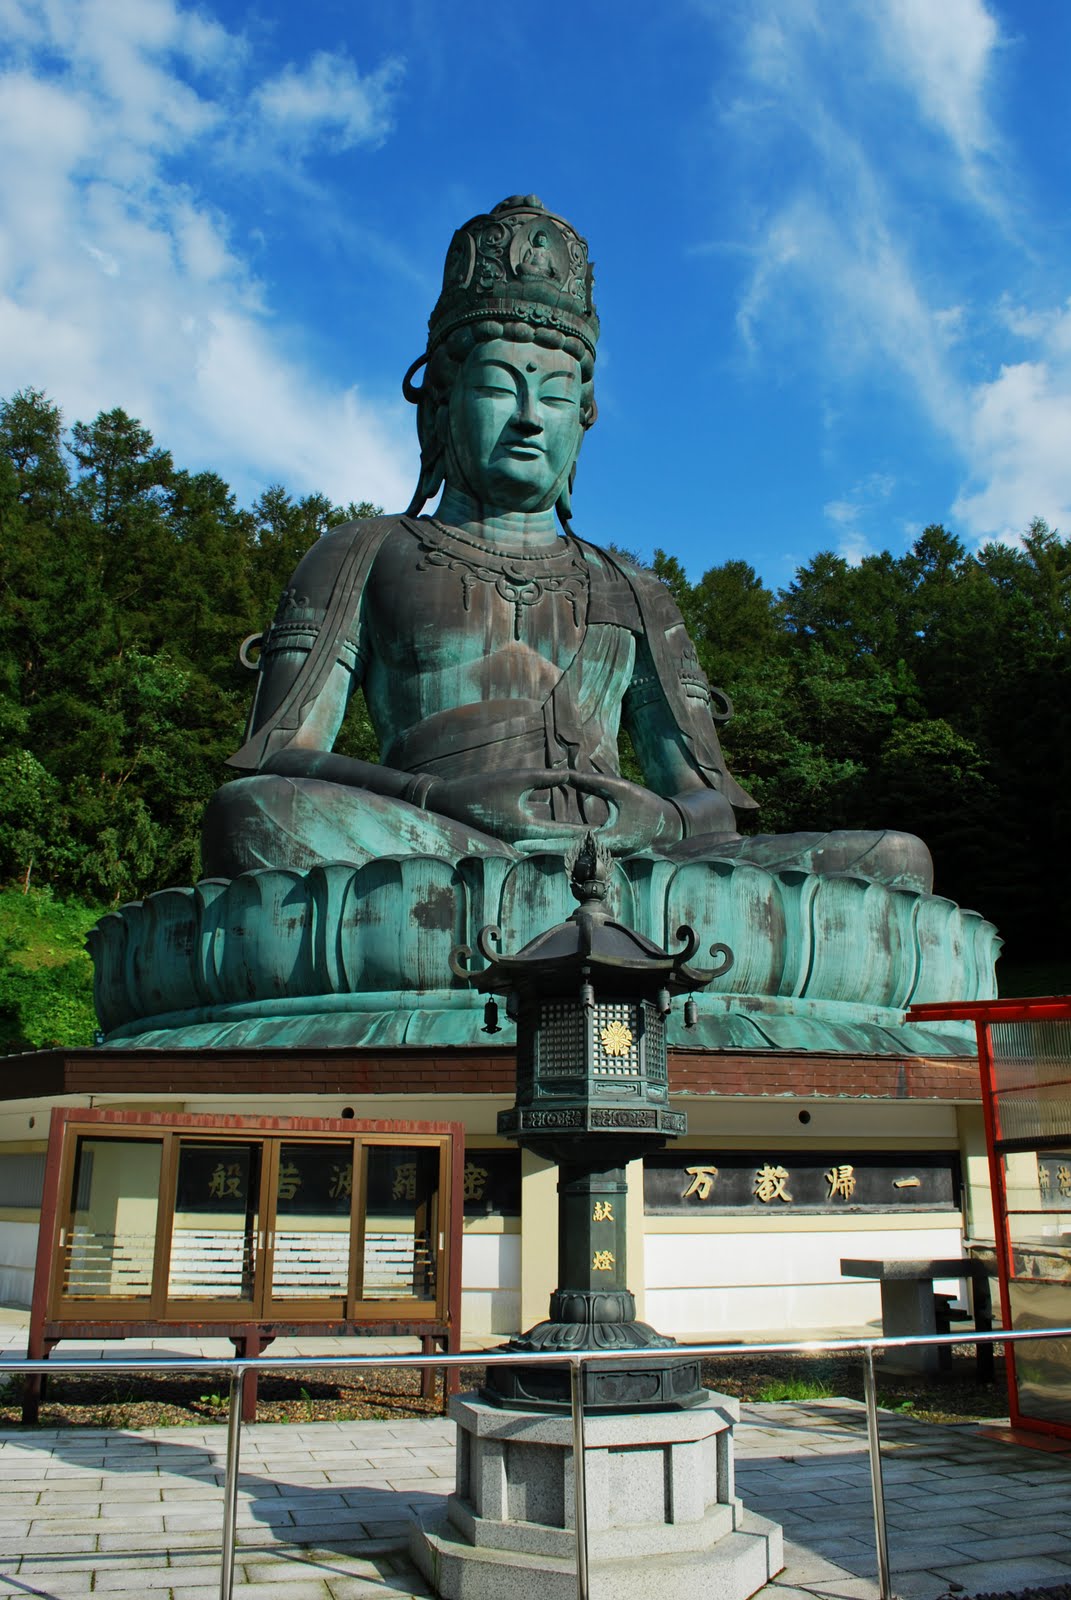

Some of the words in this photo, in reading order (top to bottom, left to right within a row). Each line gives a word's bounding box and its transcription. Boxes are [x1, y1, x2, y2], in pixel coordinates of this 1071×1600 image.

[683, 1164, 920, 1202] 万教帰一
[592, 1201, 615, 1270] 献燈
